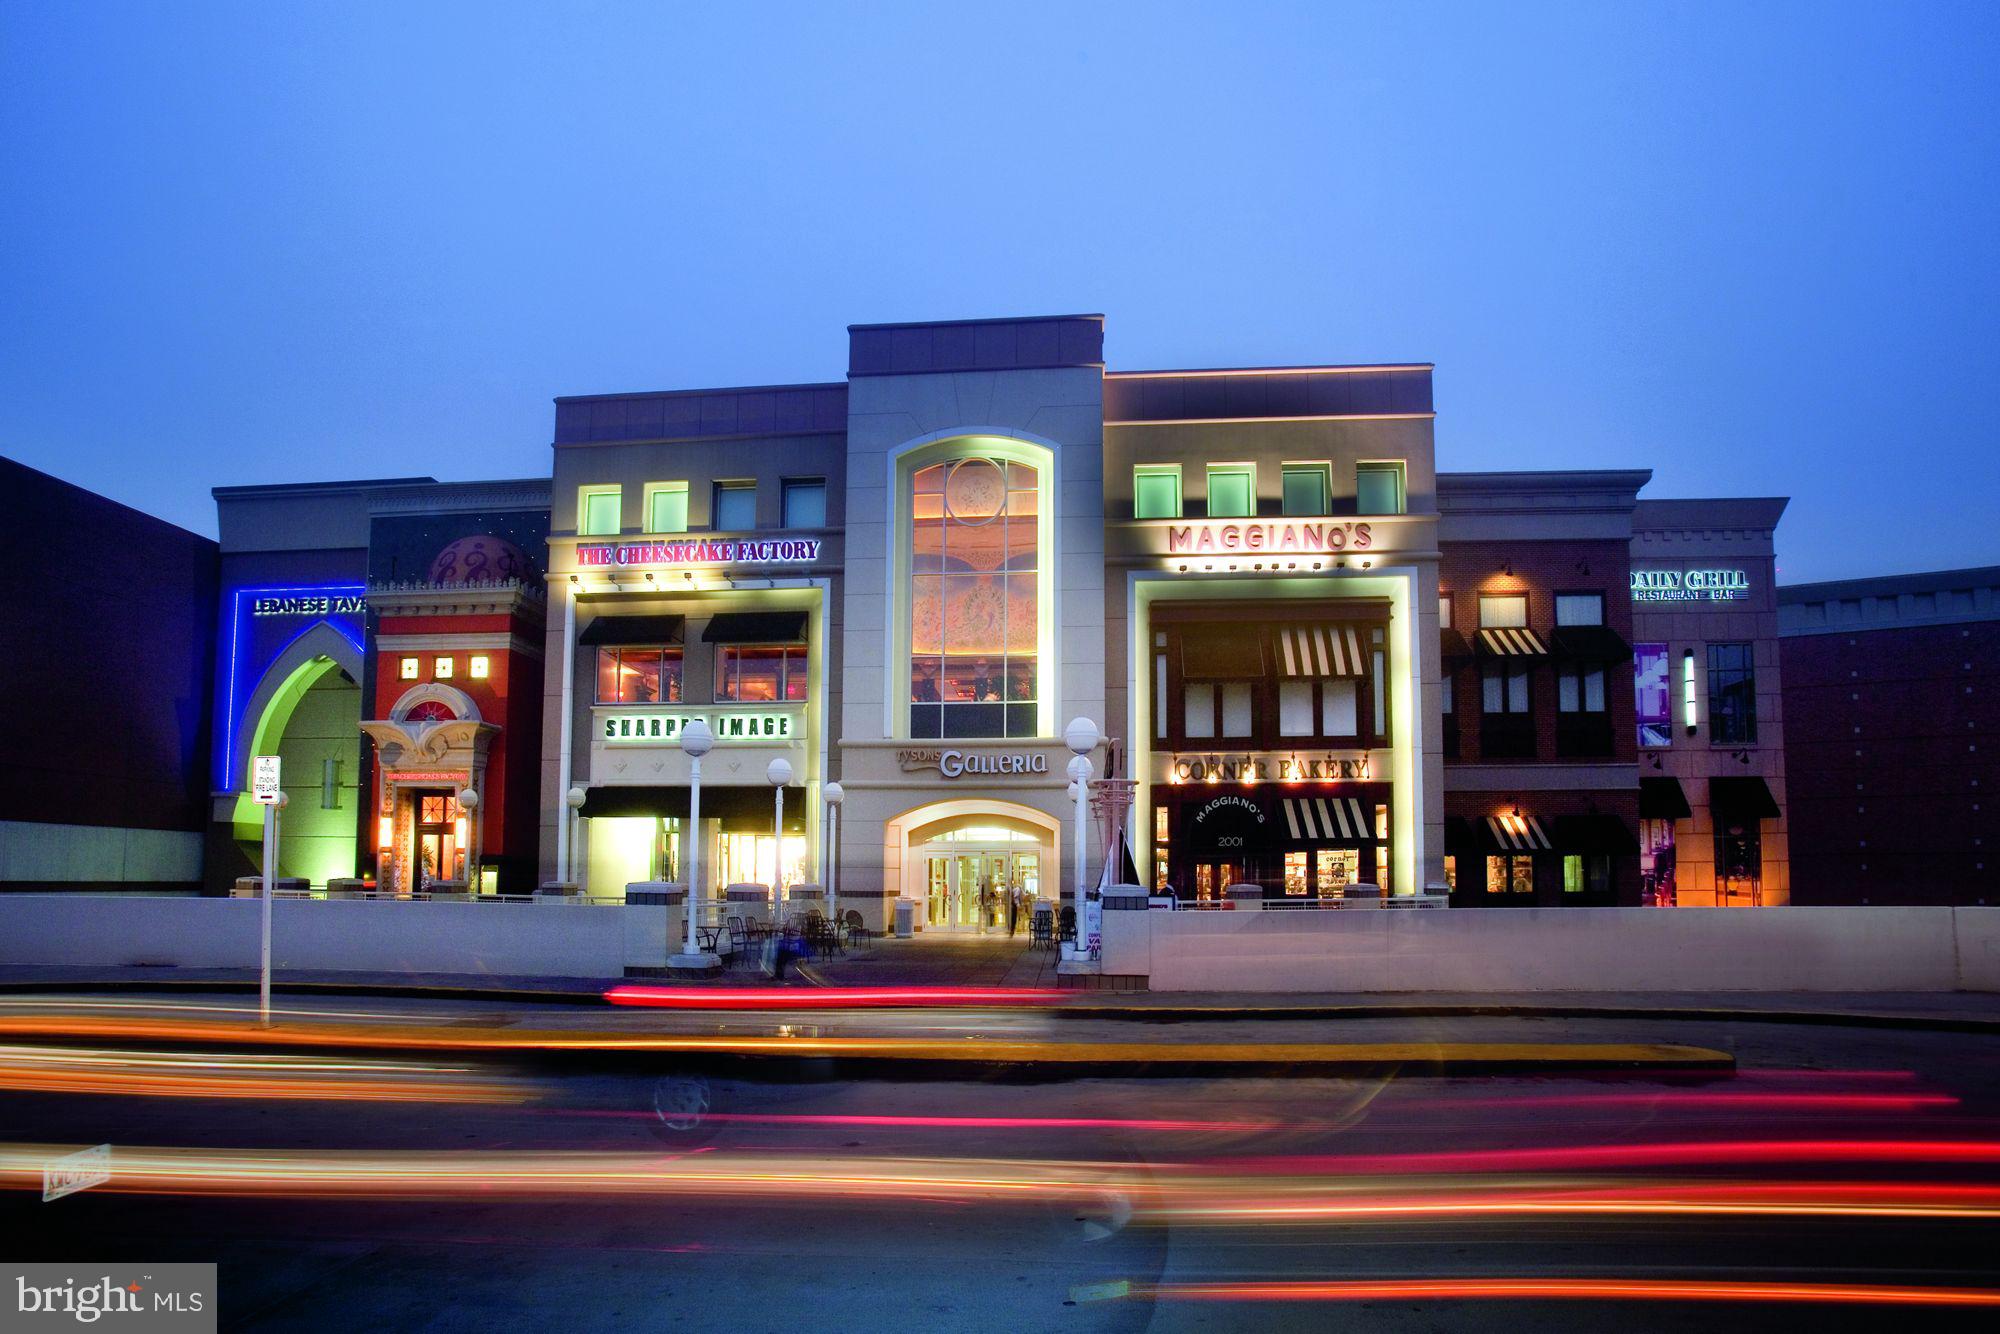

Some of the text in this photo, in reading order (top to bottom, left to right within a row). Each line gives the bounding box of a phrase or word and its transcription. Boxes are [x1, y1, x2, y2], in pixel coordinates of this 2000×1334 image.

[1170, 522, 1372, 552] MAGGIANO'S
[577, 540, 819, 566] THE CHEESECAKE FACTORY
[1685, 571, 1749, 588] GRILL
[1637, 589, 1735, 600] RESTAURANT BAR
[254, 597, 329, 615] LEBANESE
[719, 718, 787, 735] IMAGE
[897, 750, 941, 762] TYSONS
[1177, 759, 1370, 781] CORNER BAKERY
[1196, 796, 1265, 823] MAGGIANO'S
[1218, 836, 1243, 847] 2001
